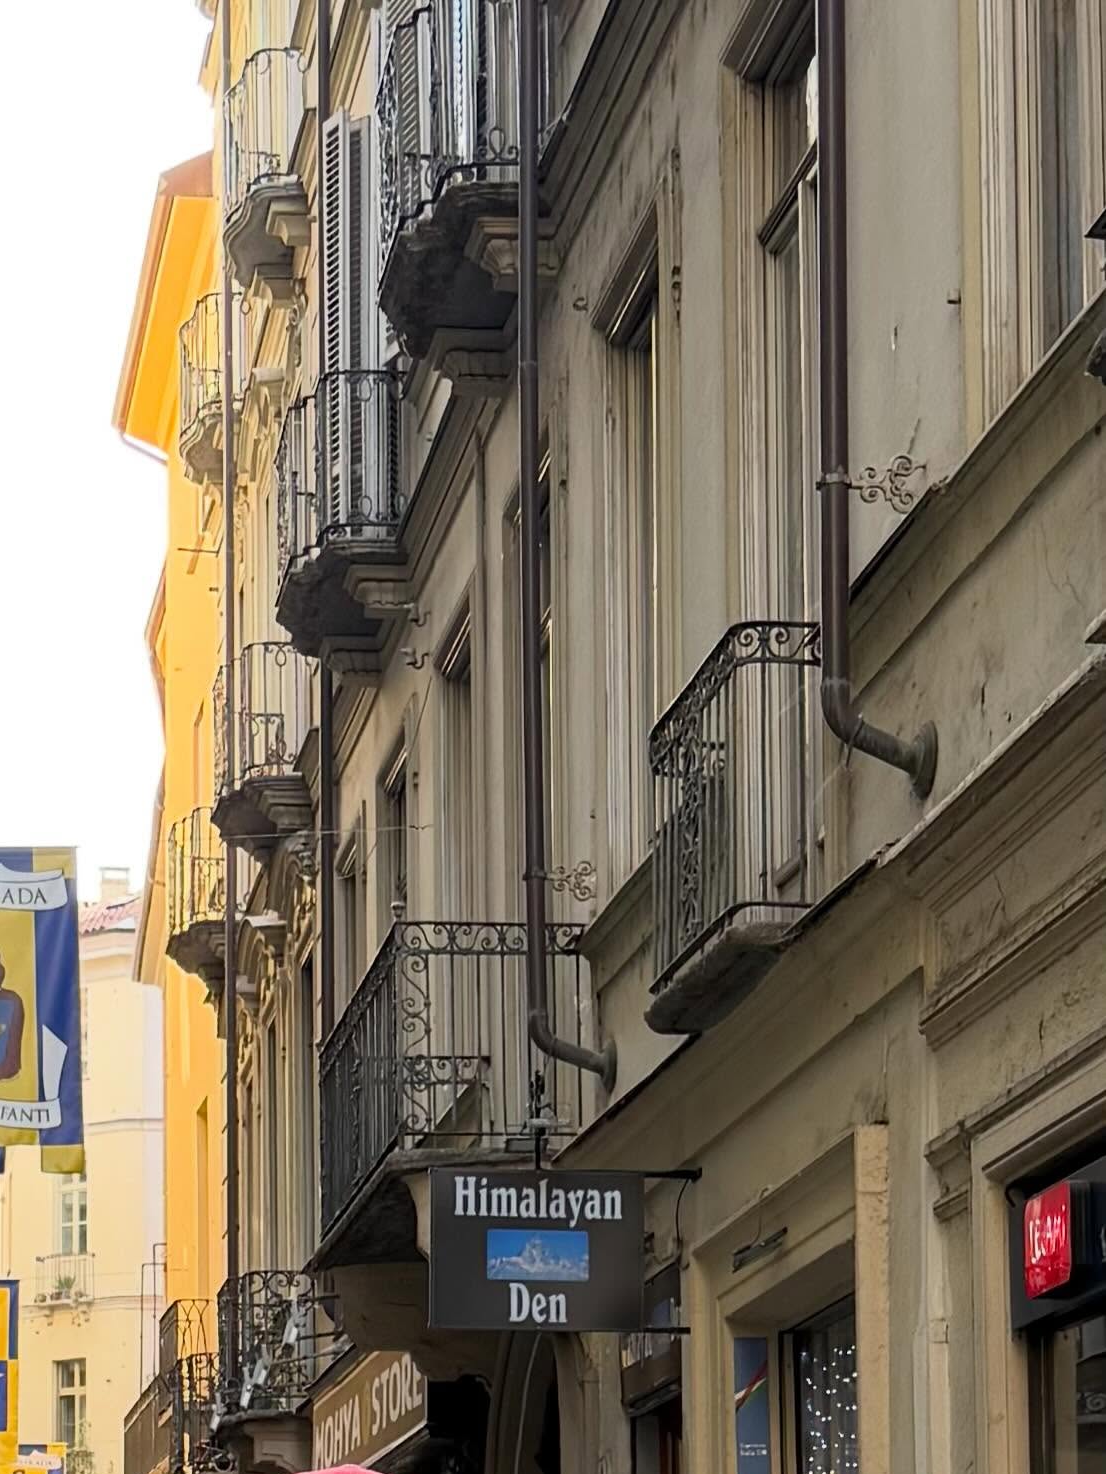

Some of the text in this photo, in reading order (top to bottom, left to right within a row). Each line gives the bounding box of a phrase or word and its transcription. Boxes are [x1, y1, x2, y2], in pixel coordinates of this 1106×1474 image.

[453, 1174, 623, 1228] Himalayan
[508, 1282, 568, 1324] Den
[371, 1352, 423, 1437] STORE
